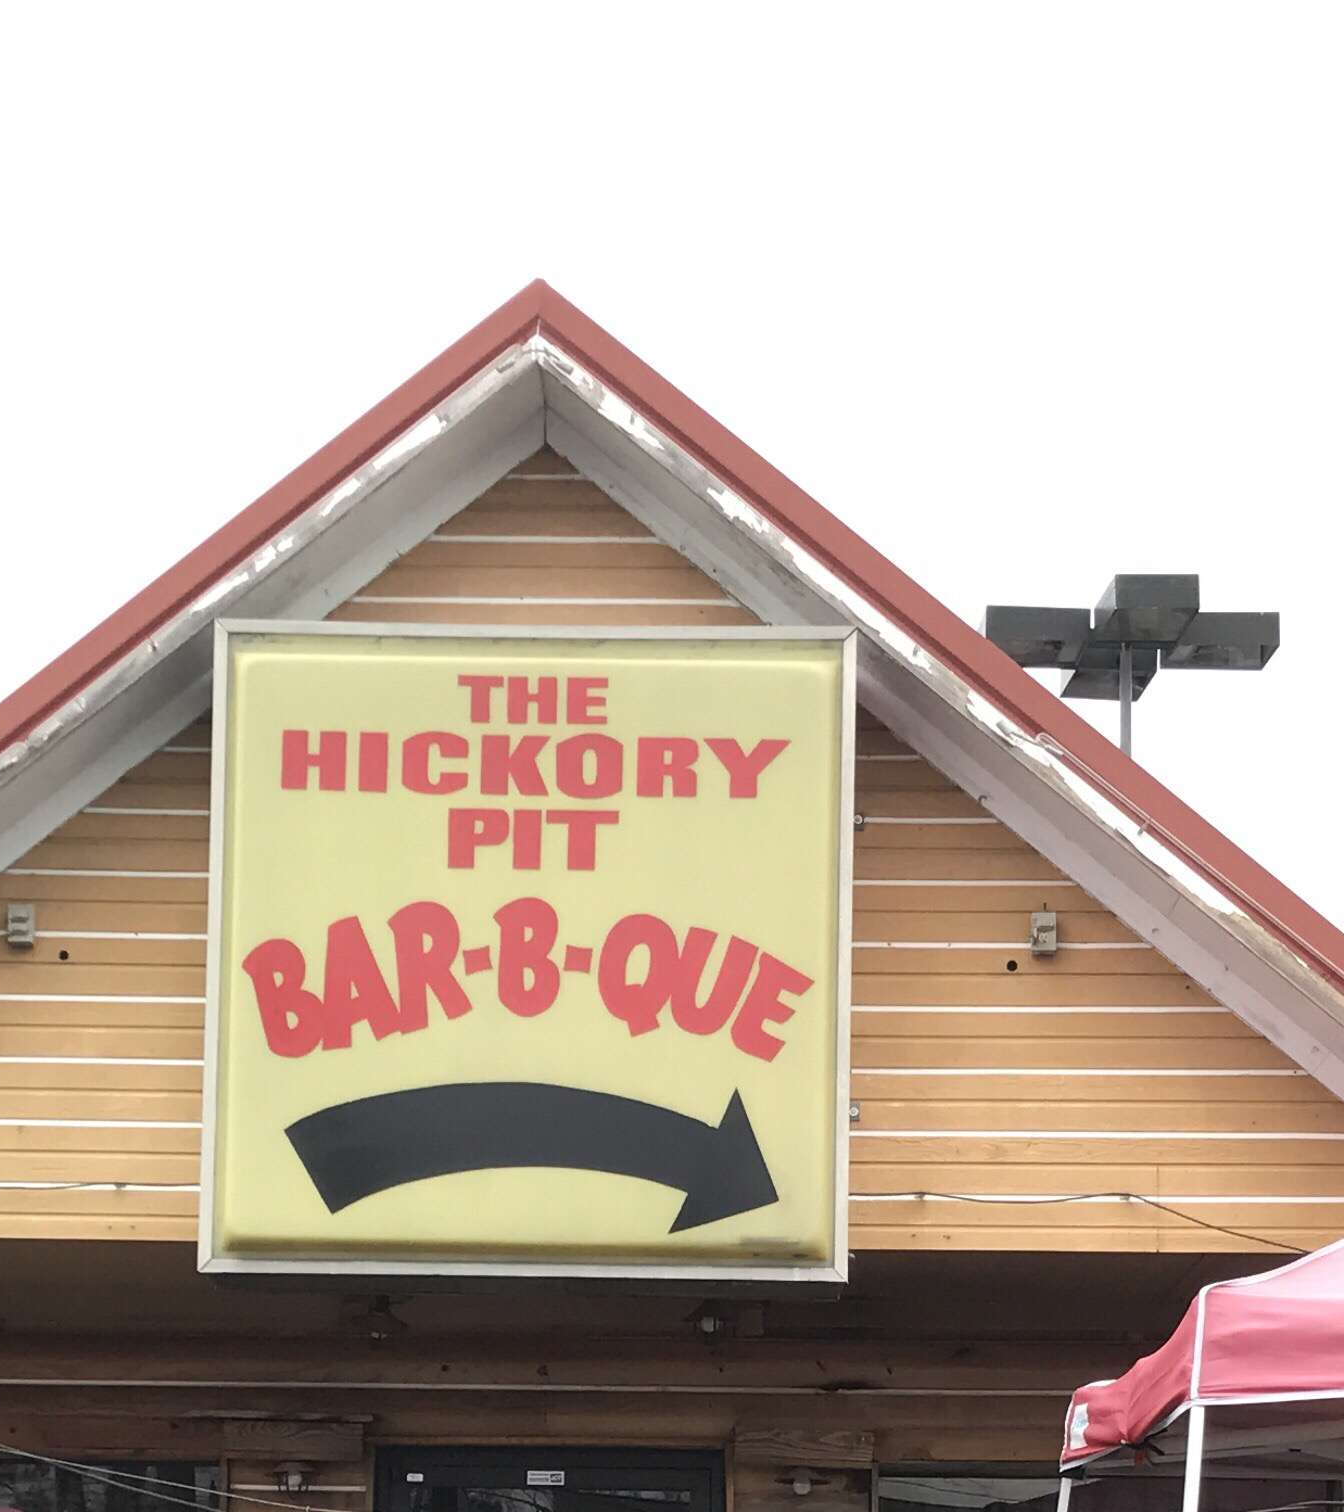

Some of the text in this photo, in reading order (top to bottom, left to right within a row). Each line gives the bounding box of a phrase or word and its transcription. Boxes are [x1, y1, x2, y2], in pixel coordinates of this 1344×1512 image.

[458, 674, 609, 725] THE
[281, 730, 792, 800] HICKORY
[447, 808, 620, 871] PIT
[242, 897, 815, 1063] BAR-B-QUE
